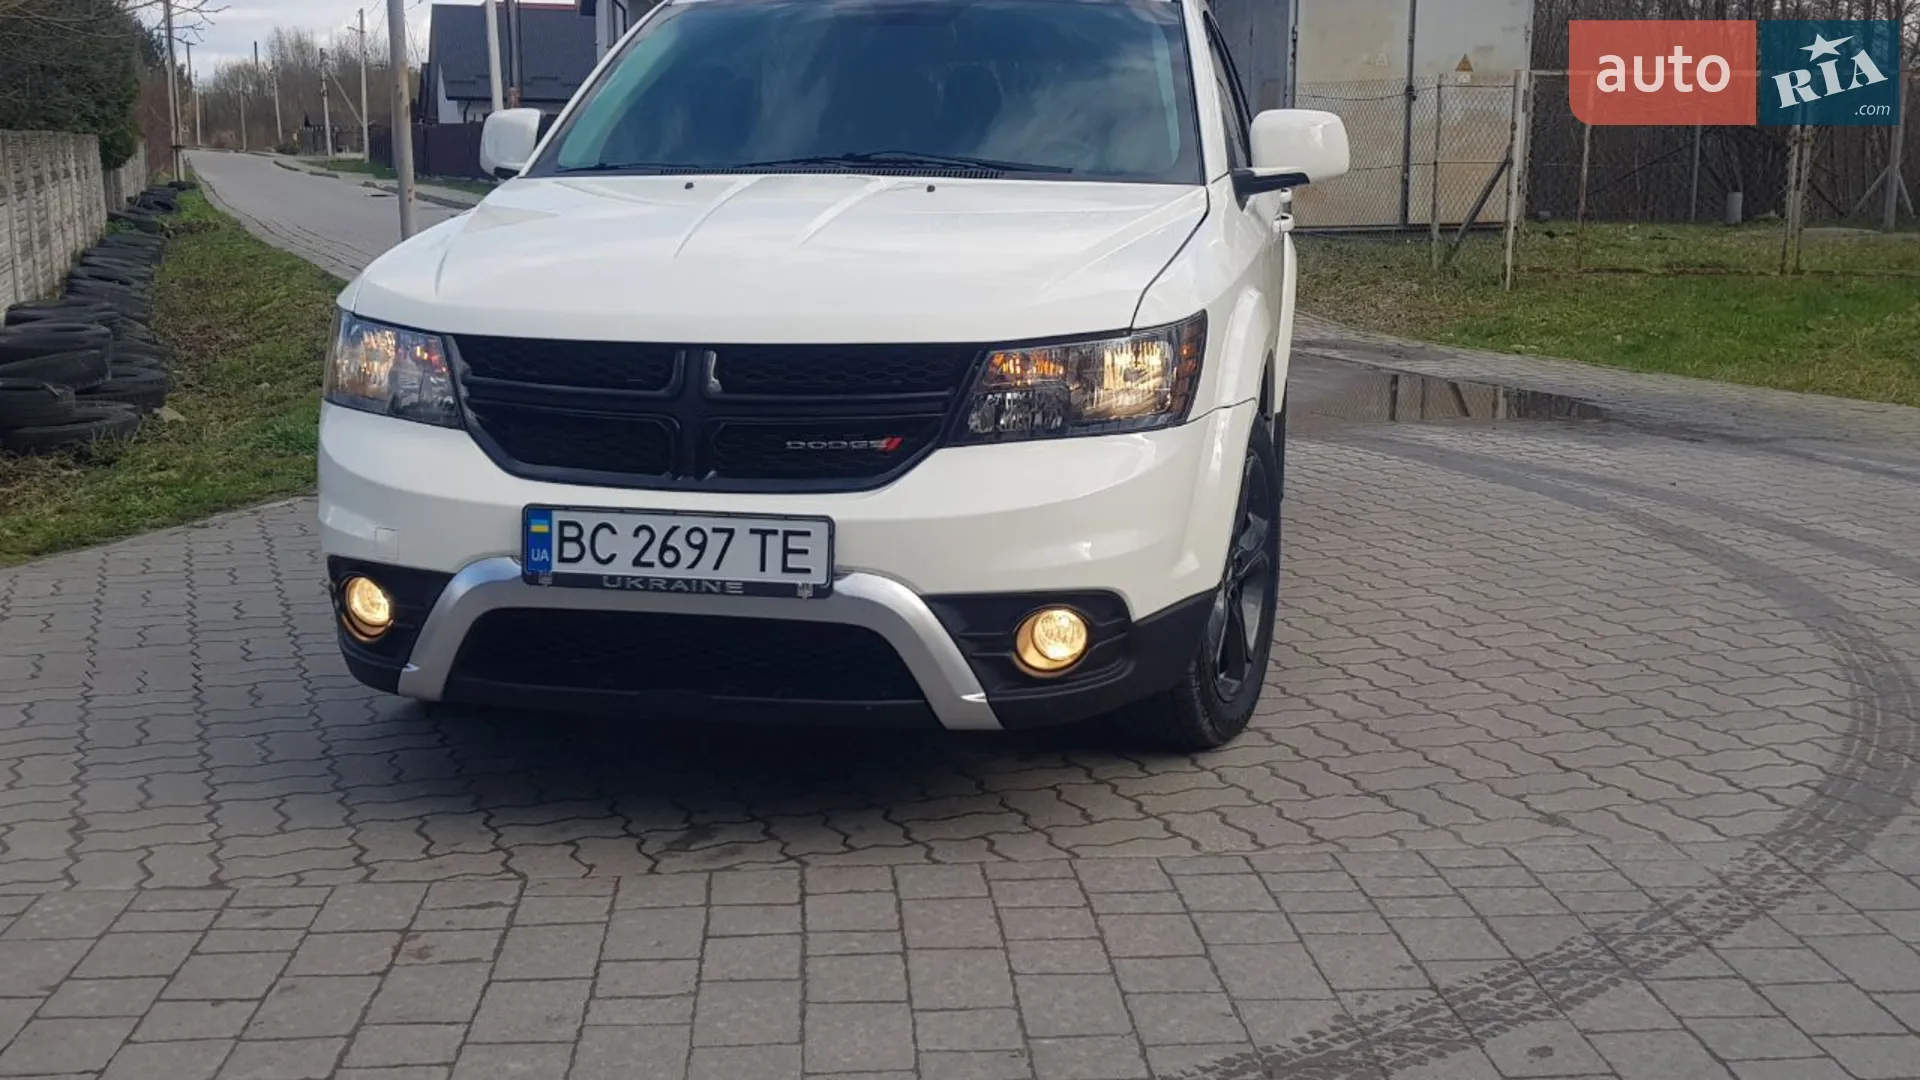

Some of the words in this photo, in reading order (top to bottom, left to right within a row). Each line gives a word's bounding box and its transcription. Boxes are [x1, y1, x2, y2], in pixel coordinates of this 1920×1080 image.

[786, 440, 889, 450] DODGE
[531, 548, 549, 563] UA
[557, 520, 618, 565] BC
[632, 524, 735, 571] 2697
[749, 528, 812, 574] TE
[602, 575, 744, 595] UKRAINE
